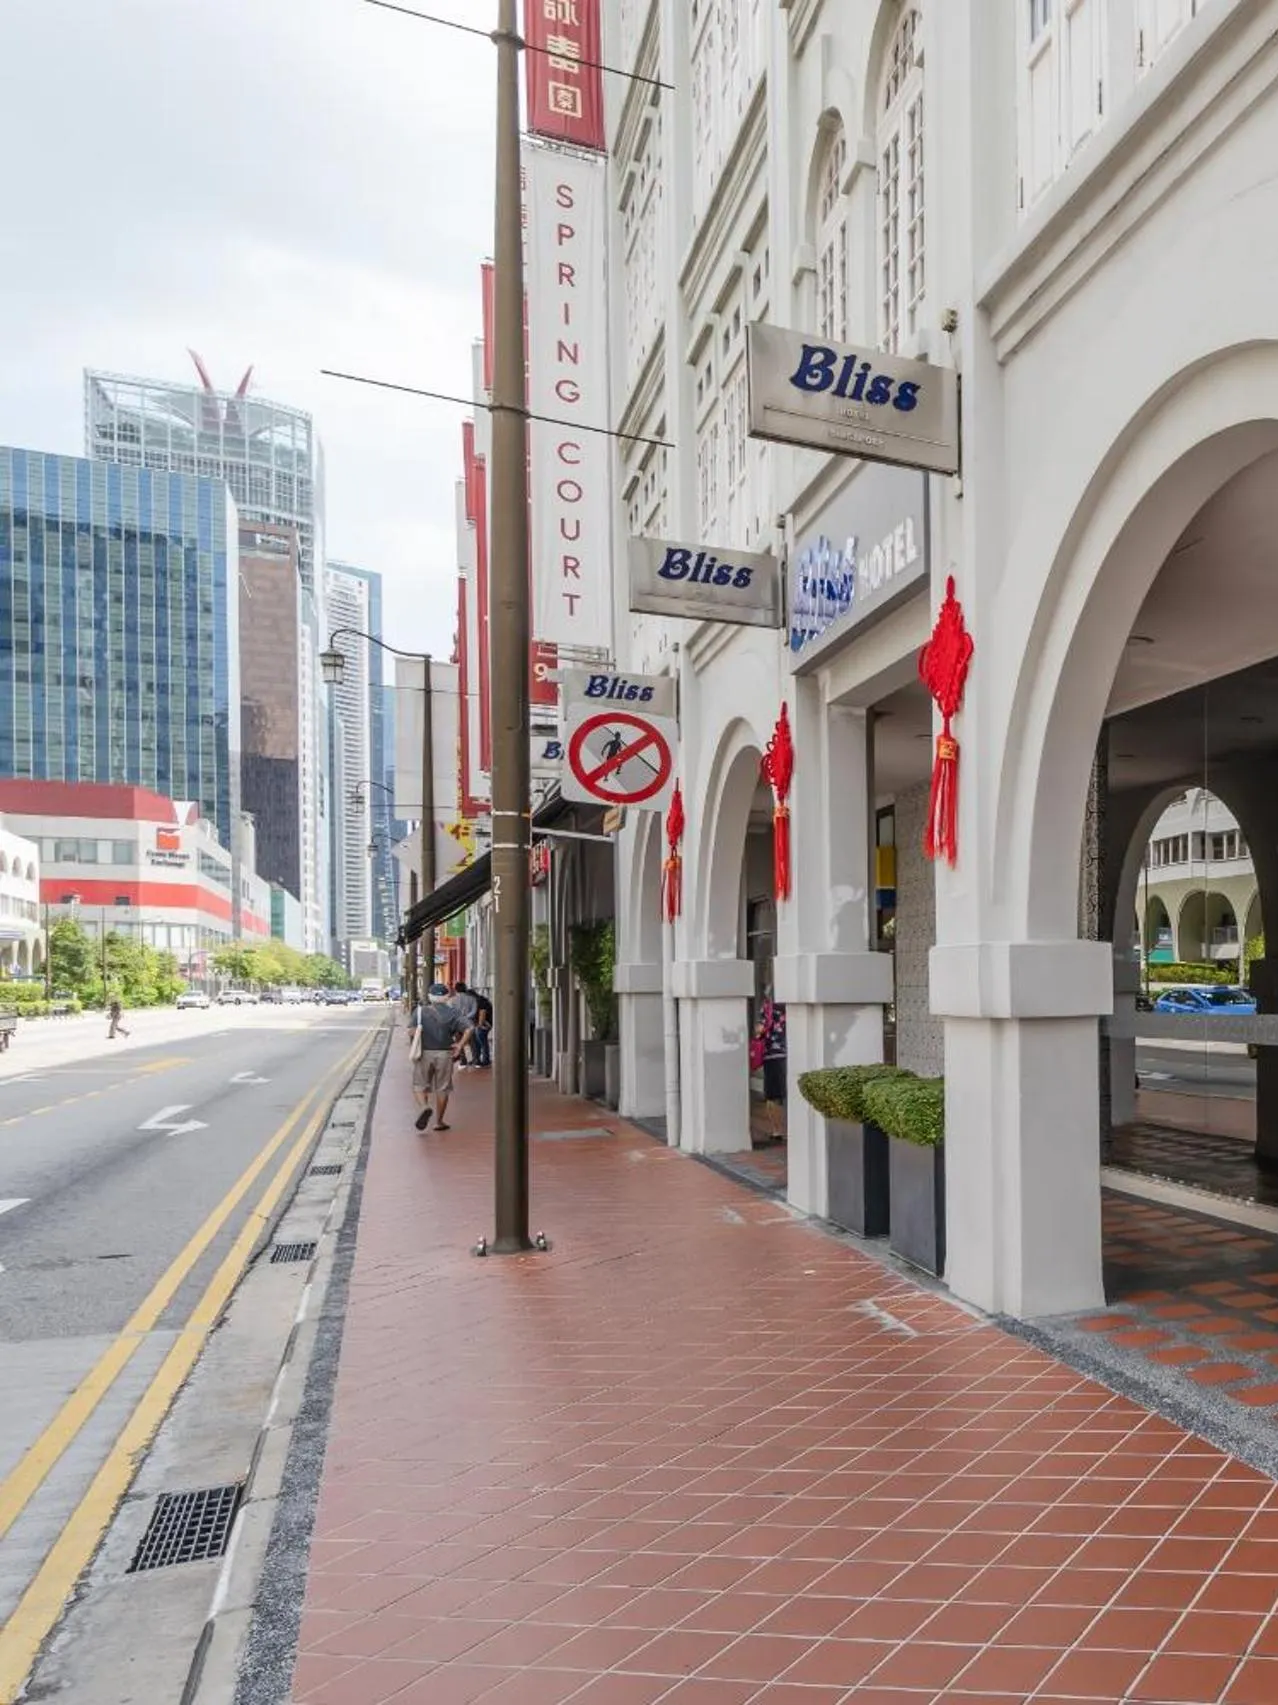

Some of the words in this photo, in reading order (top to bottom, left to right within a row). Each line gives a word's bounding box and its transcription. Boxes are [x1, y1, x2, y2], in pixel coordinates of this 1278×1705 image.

[555, 183, 580, 403] SPRING
[789, 343, 921, 412] Bliss
[556, 441, 583, 617] COURT
[657, 547, 754, 588] Bliss
[858, 516, 917, 601] HOTEL
[584, 675, 654, 702] Bliss
